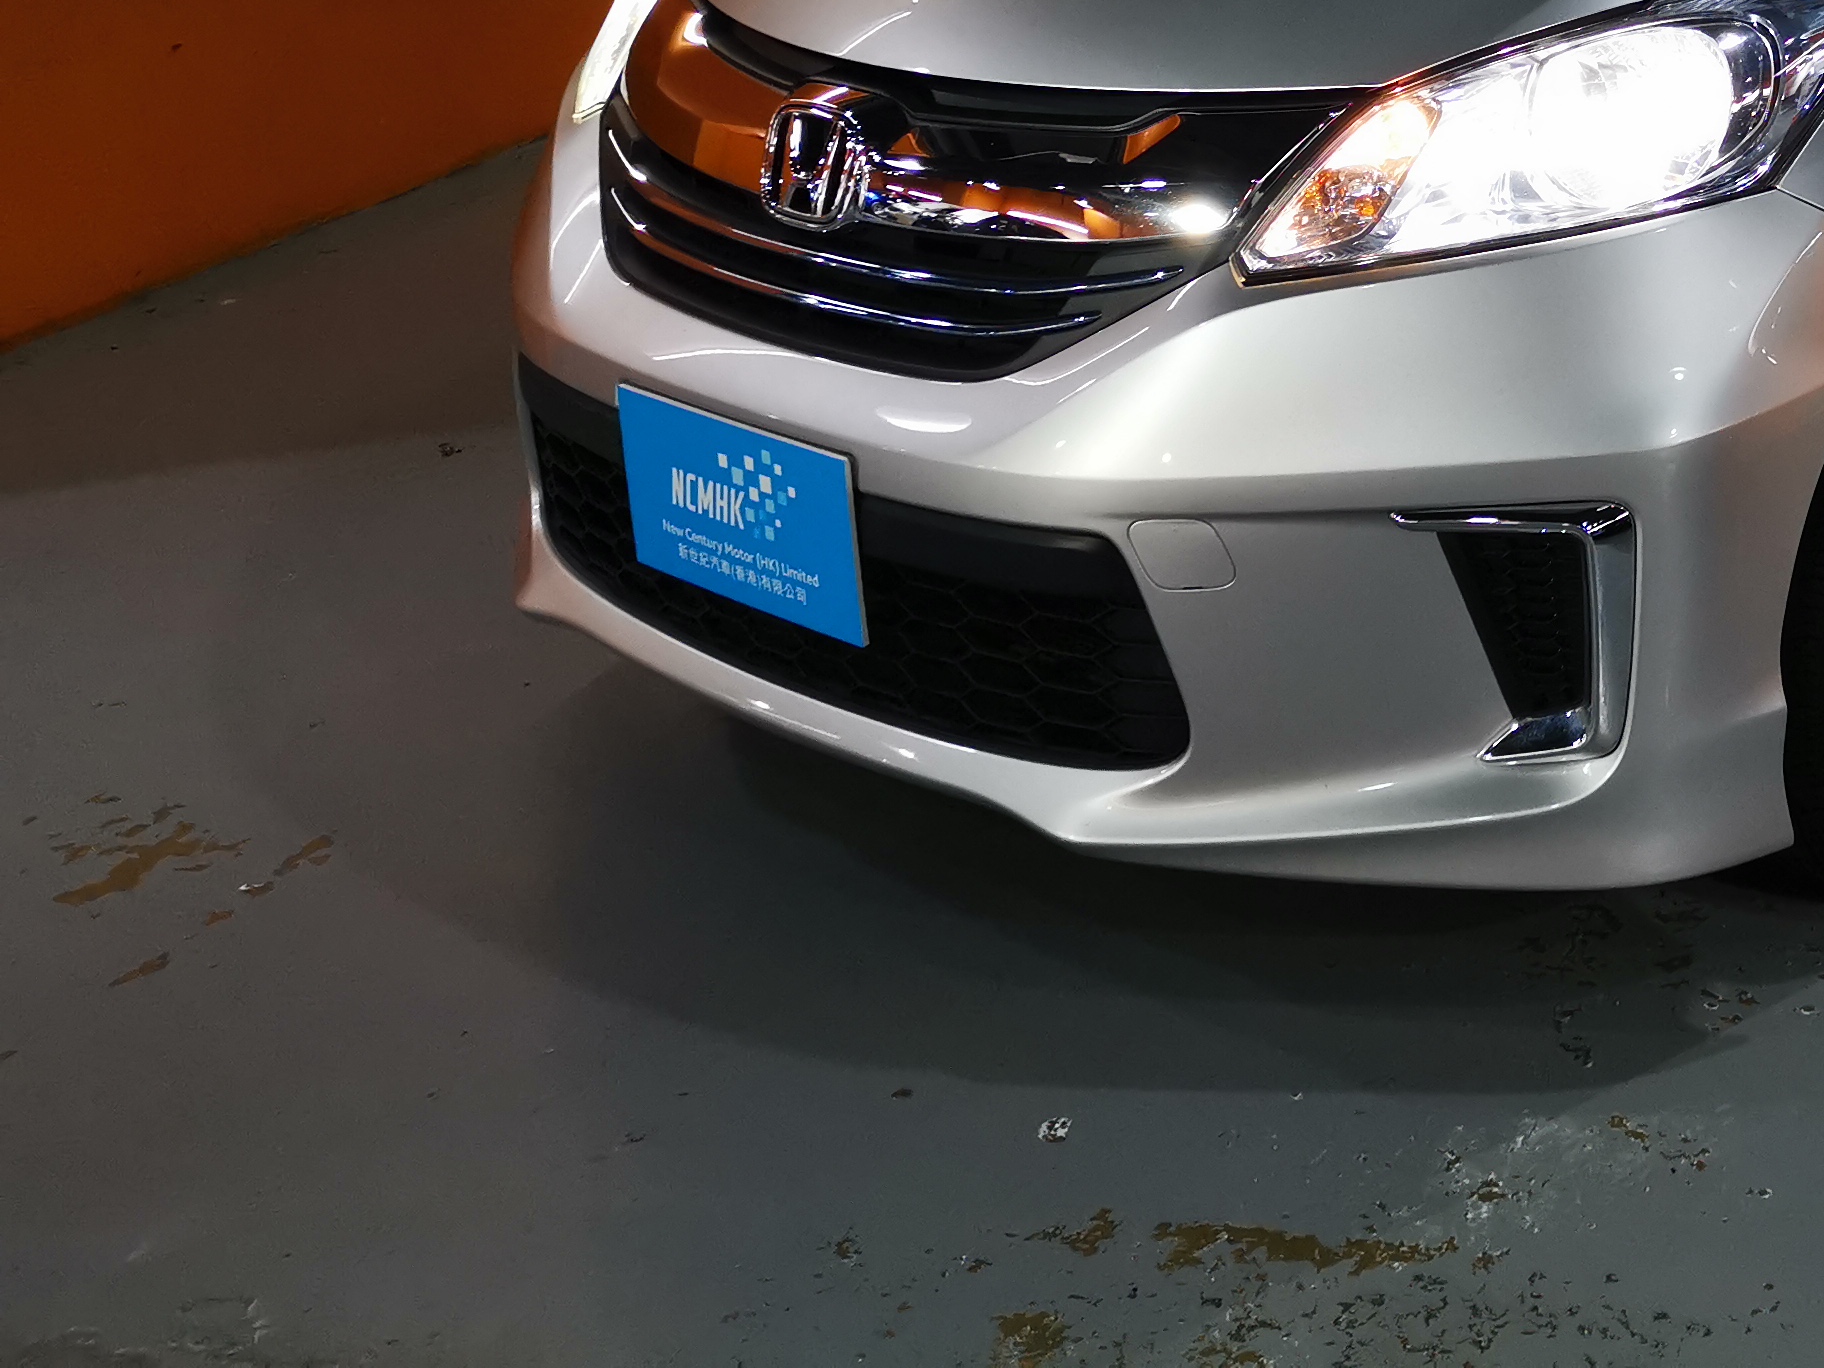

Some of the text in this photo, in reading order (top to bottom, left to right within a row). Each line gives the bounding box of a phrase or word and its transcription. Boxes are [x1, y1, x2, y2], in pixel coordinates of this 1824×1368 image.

[672, 467, 745, 530] NCMHK
[662, 518, 684, 536] New
[685, 527, 723, 556] Century
[724, 541, 755, 564] Motor
[781, 562, 820, 588] Limited
